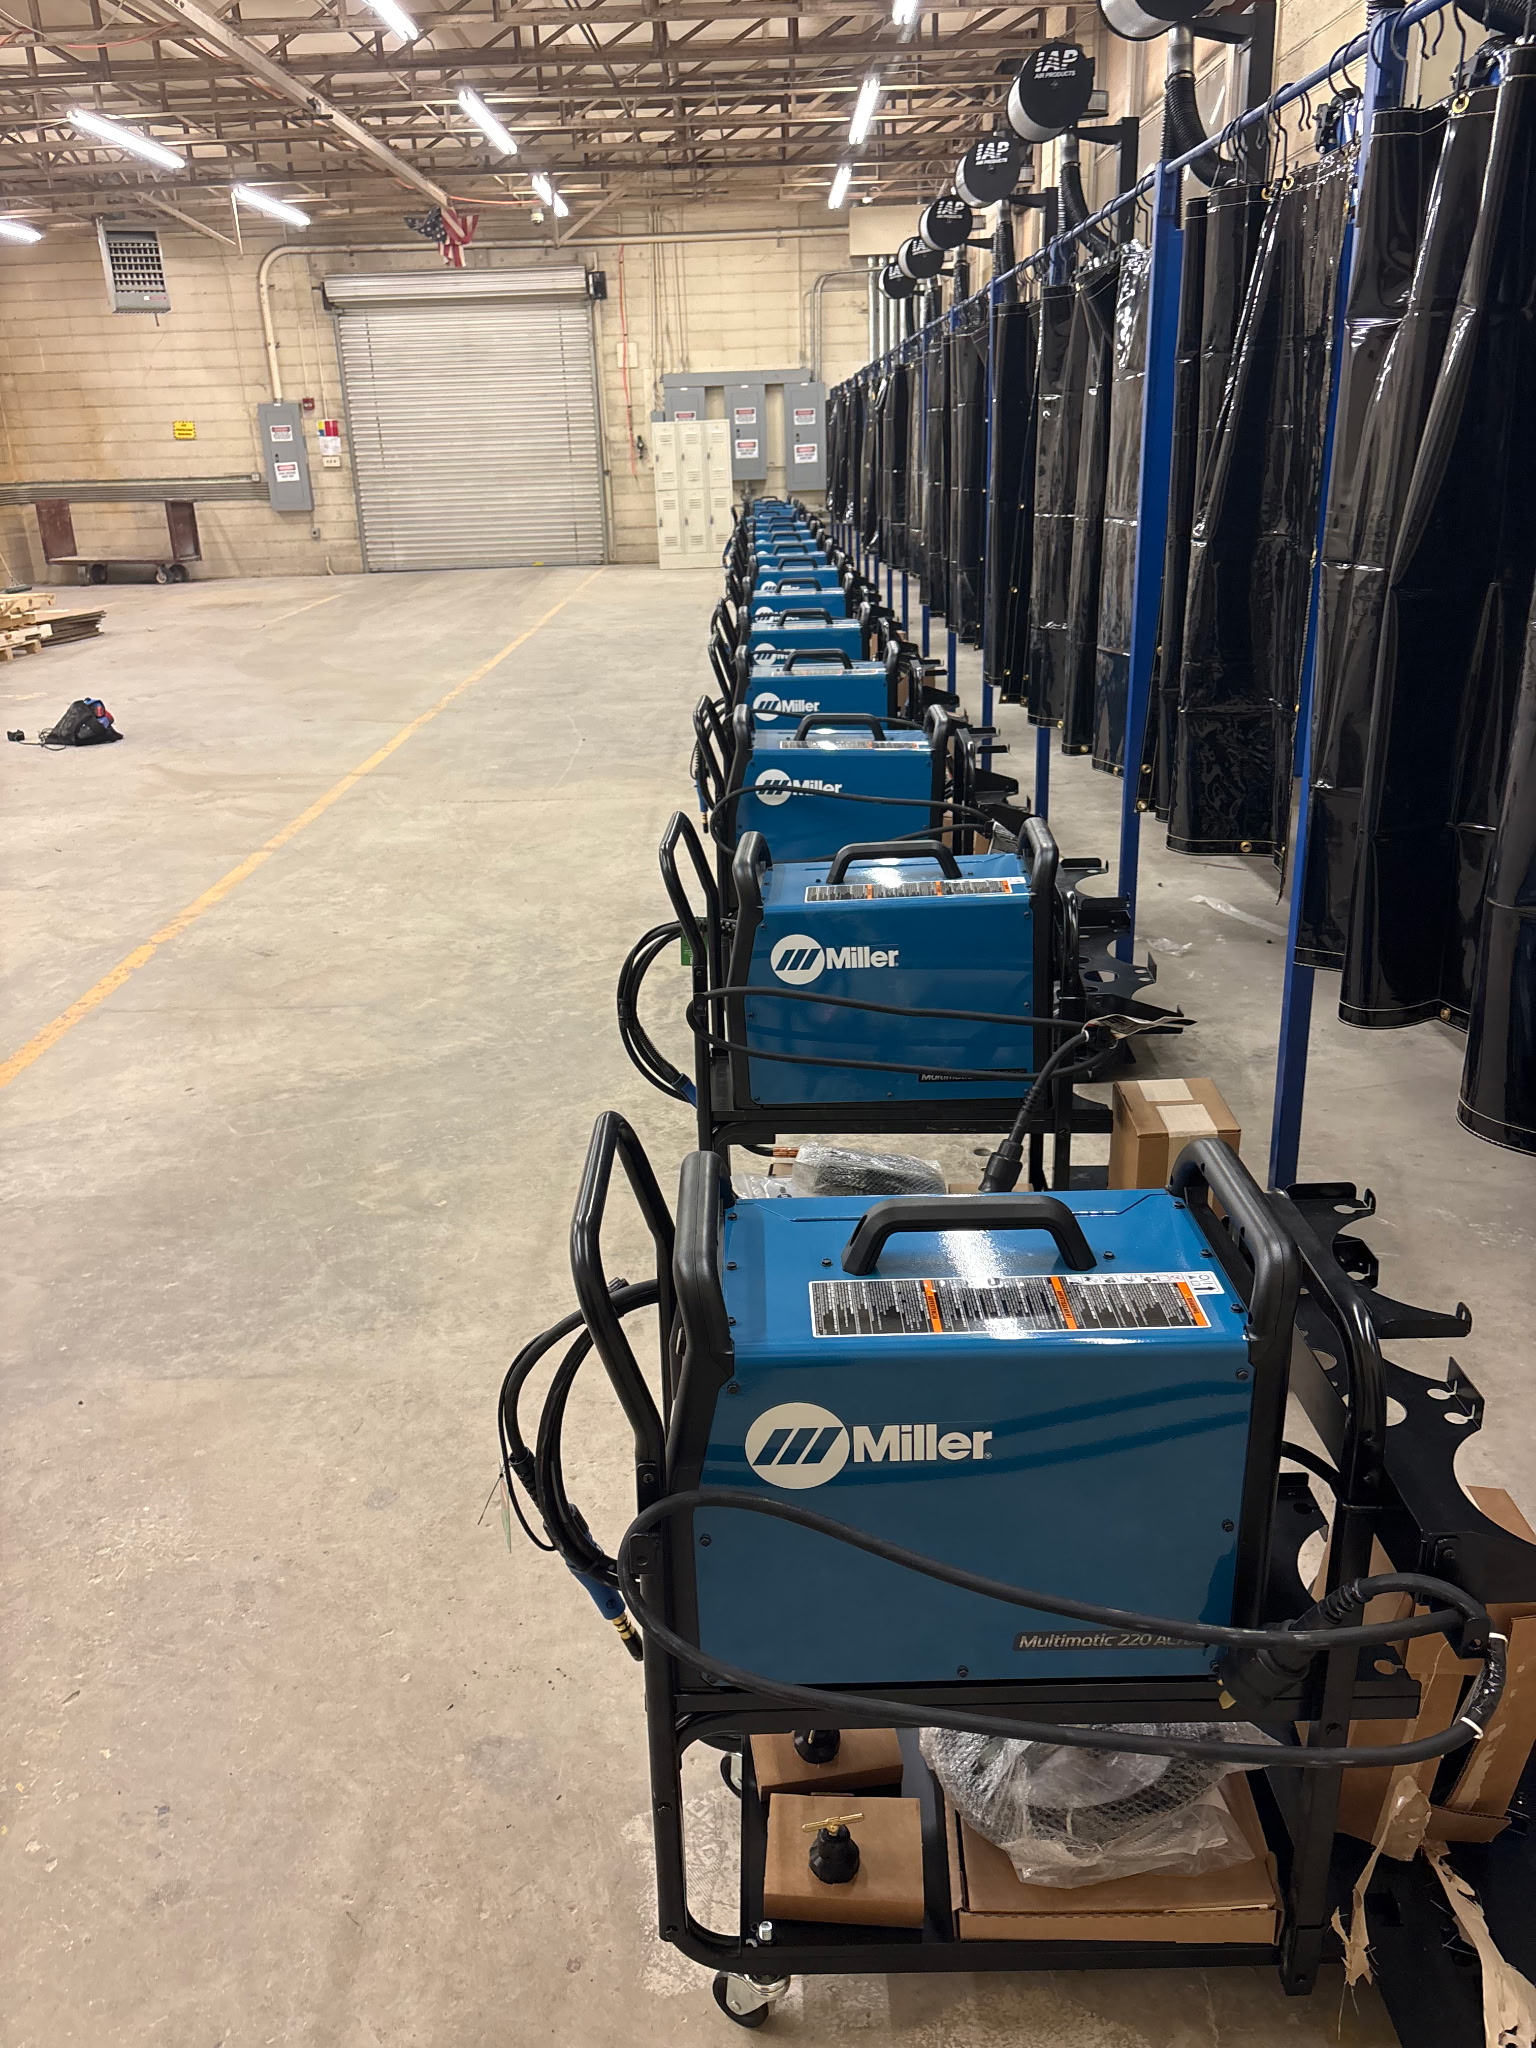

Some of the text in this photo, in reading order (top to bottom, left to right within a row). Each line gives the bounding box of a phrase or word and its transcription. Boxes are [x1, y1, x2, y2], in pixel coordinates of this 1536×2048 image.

[1034, 49, 1079, 73] IAP
[1034, 70, 1077, 80] AIR PRODUCTS
[975, 141, 1010, 161] IAP
[936, 200, 965, 215] IAP
[781, 699, 821, 713] Miller
[826, 946, 900, 971] Miller
[853, 1423, 993, 1463] Miller
[1018, 1632, 1118, 1649] Multimatic
[1117, 1633, 1152, 1647] 220
